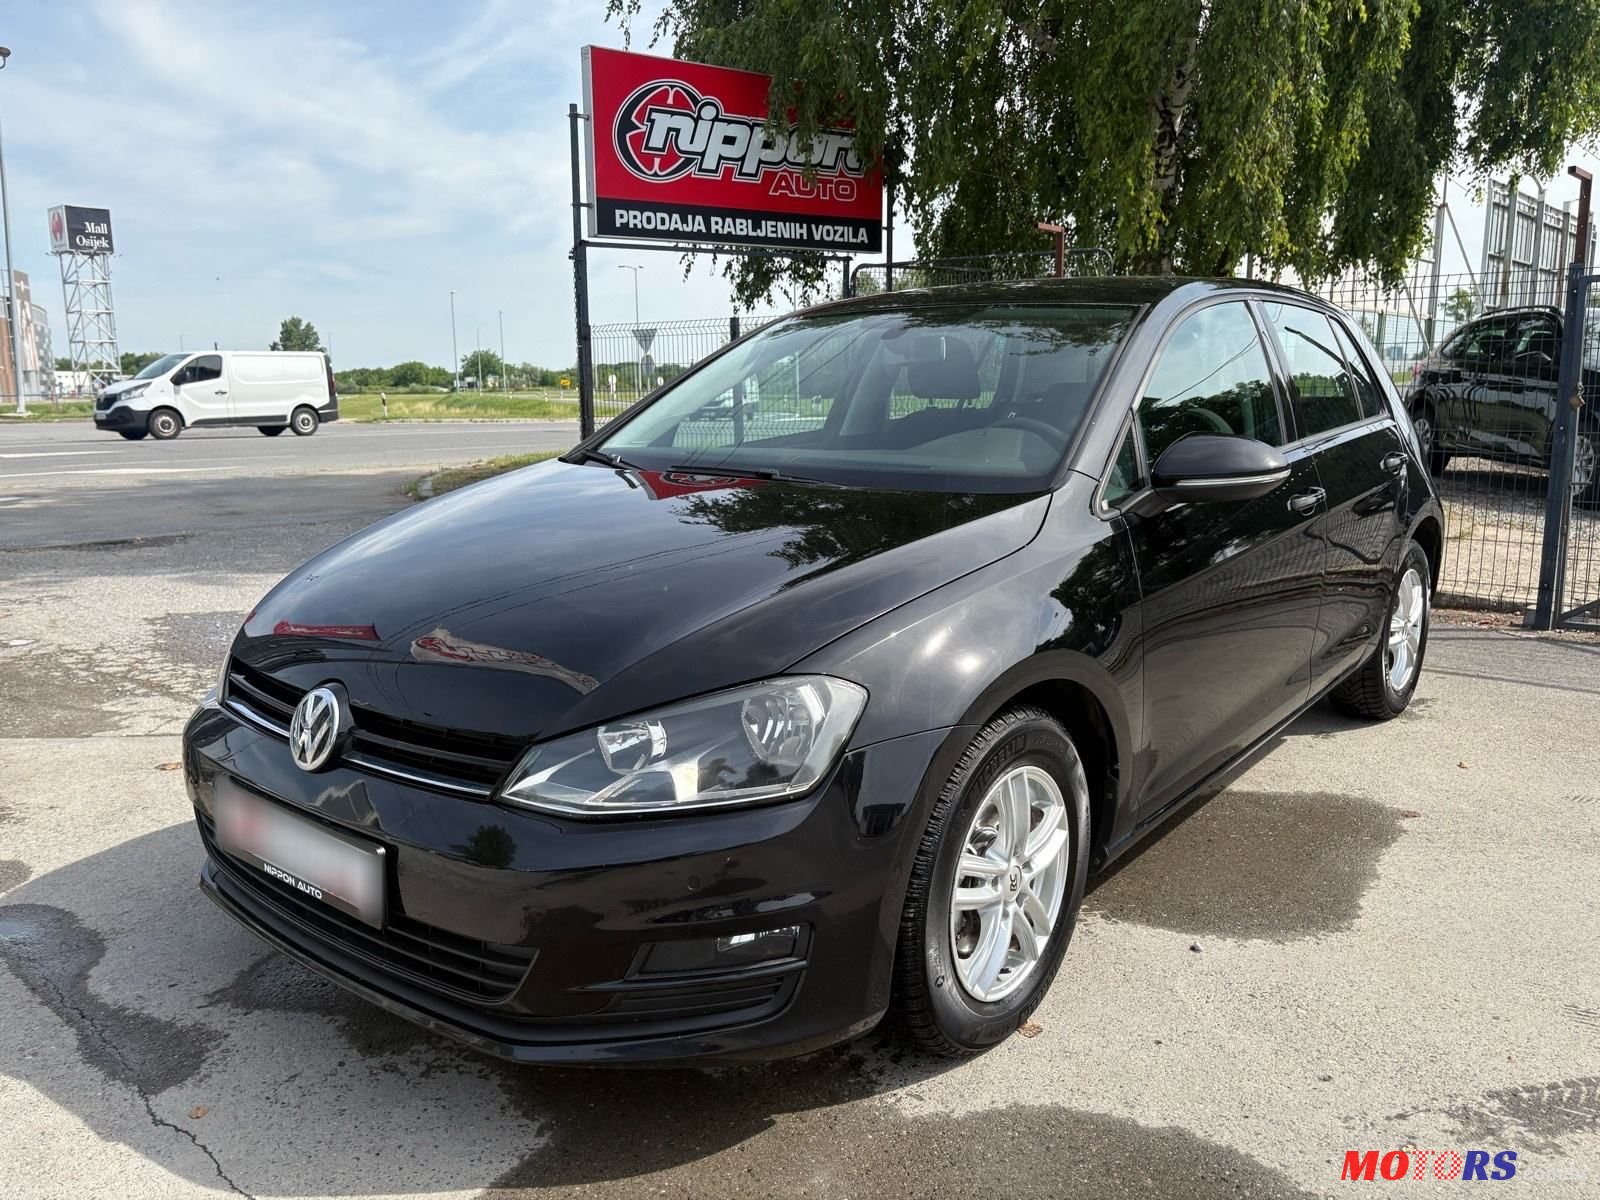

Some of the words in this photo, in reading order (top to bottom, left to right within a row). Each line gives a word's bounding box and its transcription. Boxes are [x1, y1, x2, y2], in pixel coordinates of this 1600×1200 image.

[648, 104, 861, 174] nippon
[769, 172, 857, 202] AUTO
[76, 235, 110, 249] Osijek
[84, 221, 108, 234] Mall
[614, 208, 707, 234] PRODAJA
[710, 216, 808, 242] RABLJENIH
[811, 223, 869, 244] VOZILA
[263, 862, 296, 887] NIPPON
[297, 880, 323, 900] AUTO
